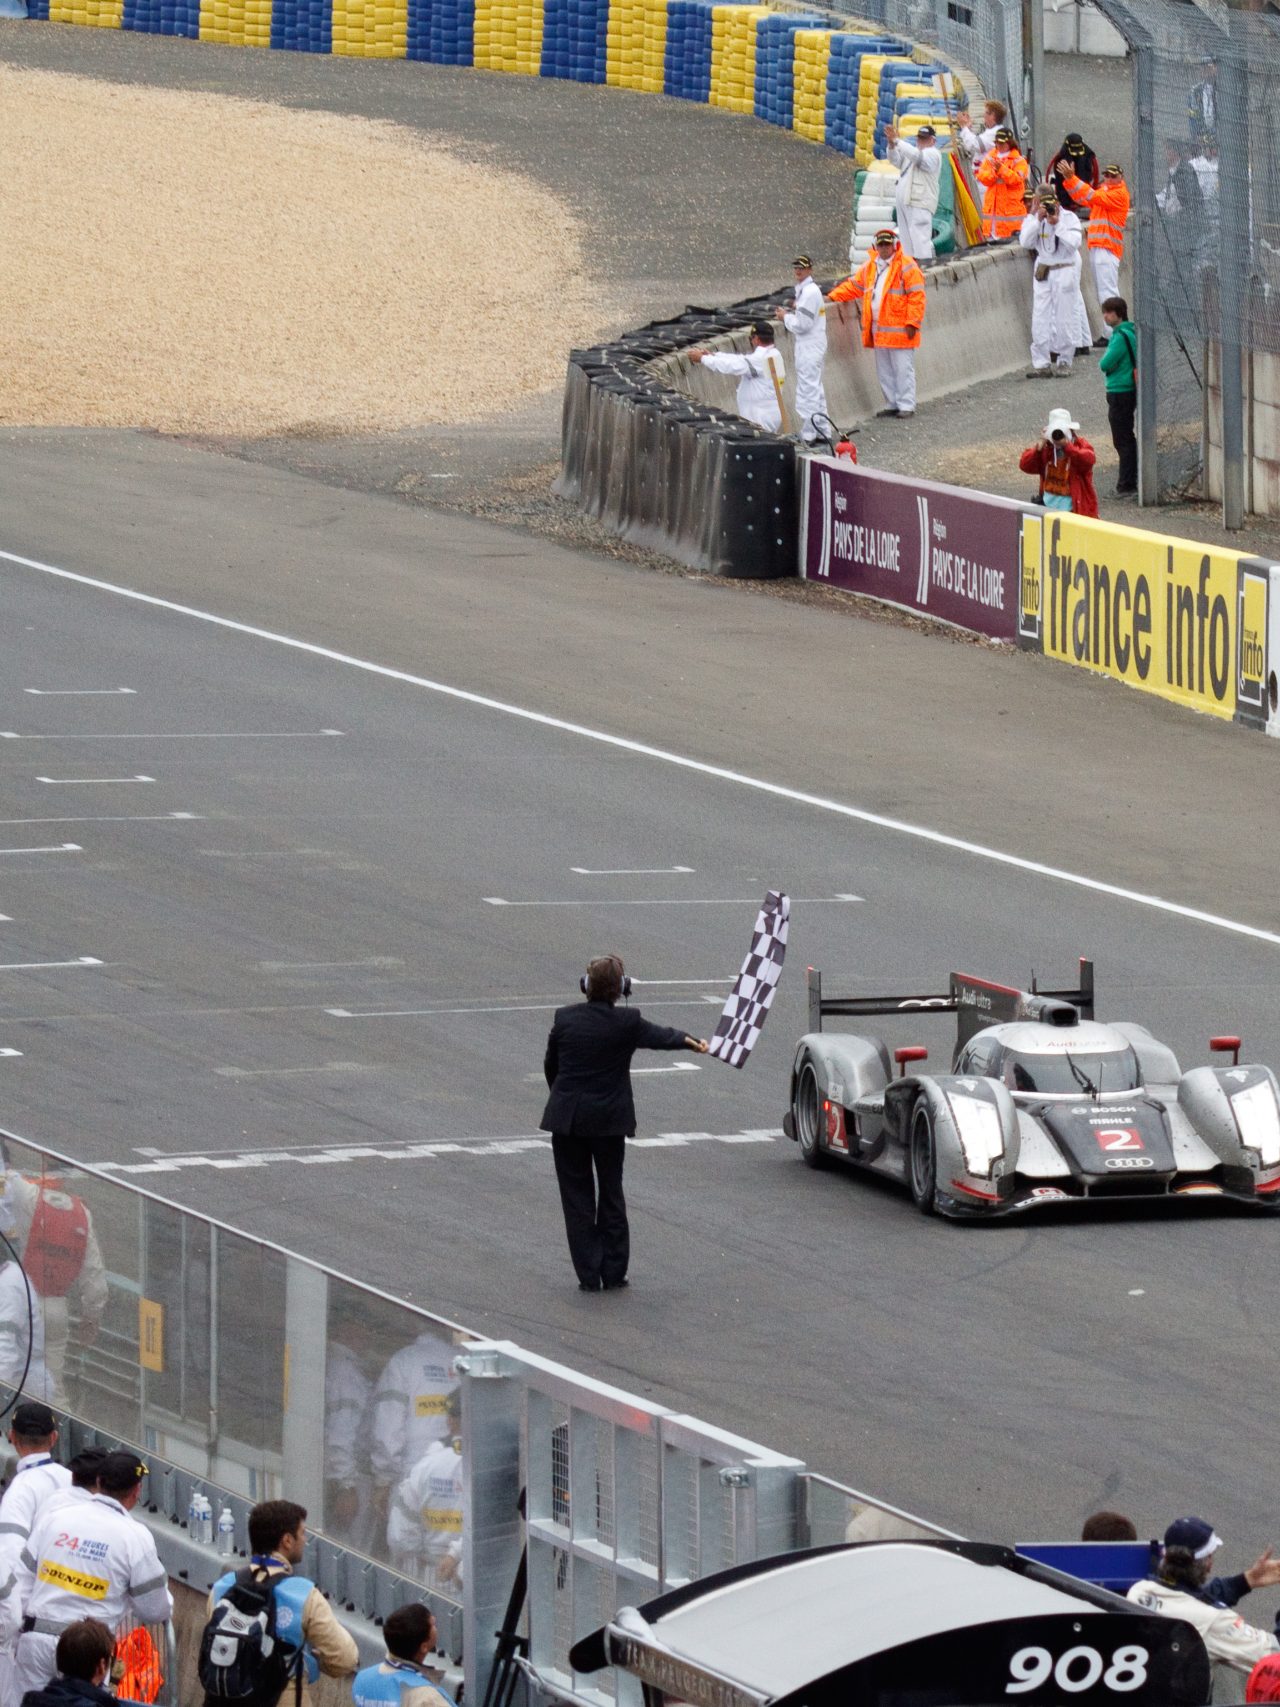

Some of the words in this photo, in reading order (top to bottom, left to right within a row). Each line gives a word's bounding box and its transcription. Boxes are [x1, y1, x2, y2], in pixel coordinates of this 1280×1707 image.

[834, 520, 853, 562] PAYS
[853, 525, 865, 564] DE
[865, 528, 876, 566] LA
[877, 530, 900, 573] LOIRE
[932, 547, 953, 591] PAYS
[954, 555, 966, 597] DE
[967, 561, 979, 602] LA
[979, 565, 1005, 611] LOIRE
[1049, 517, 1152, 680] france
[1166, 545, 1229, 701] info
[831, 1105, 844, 1147] 2
[1089, 1117, 1134, 1125] MAHLE
[1090, 1105, 1137, 1114] BOSCH
[1099, 1129, 1141, 1151] 2
[54, 1532, 79, 1551] 24
[81, 1539, 110, 1552] HEURES
[48, 1567, 105, 1592] DUNLOP
[1004, 1645, 1150, 1695] 908
